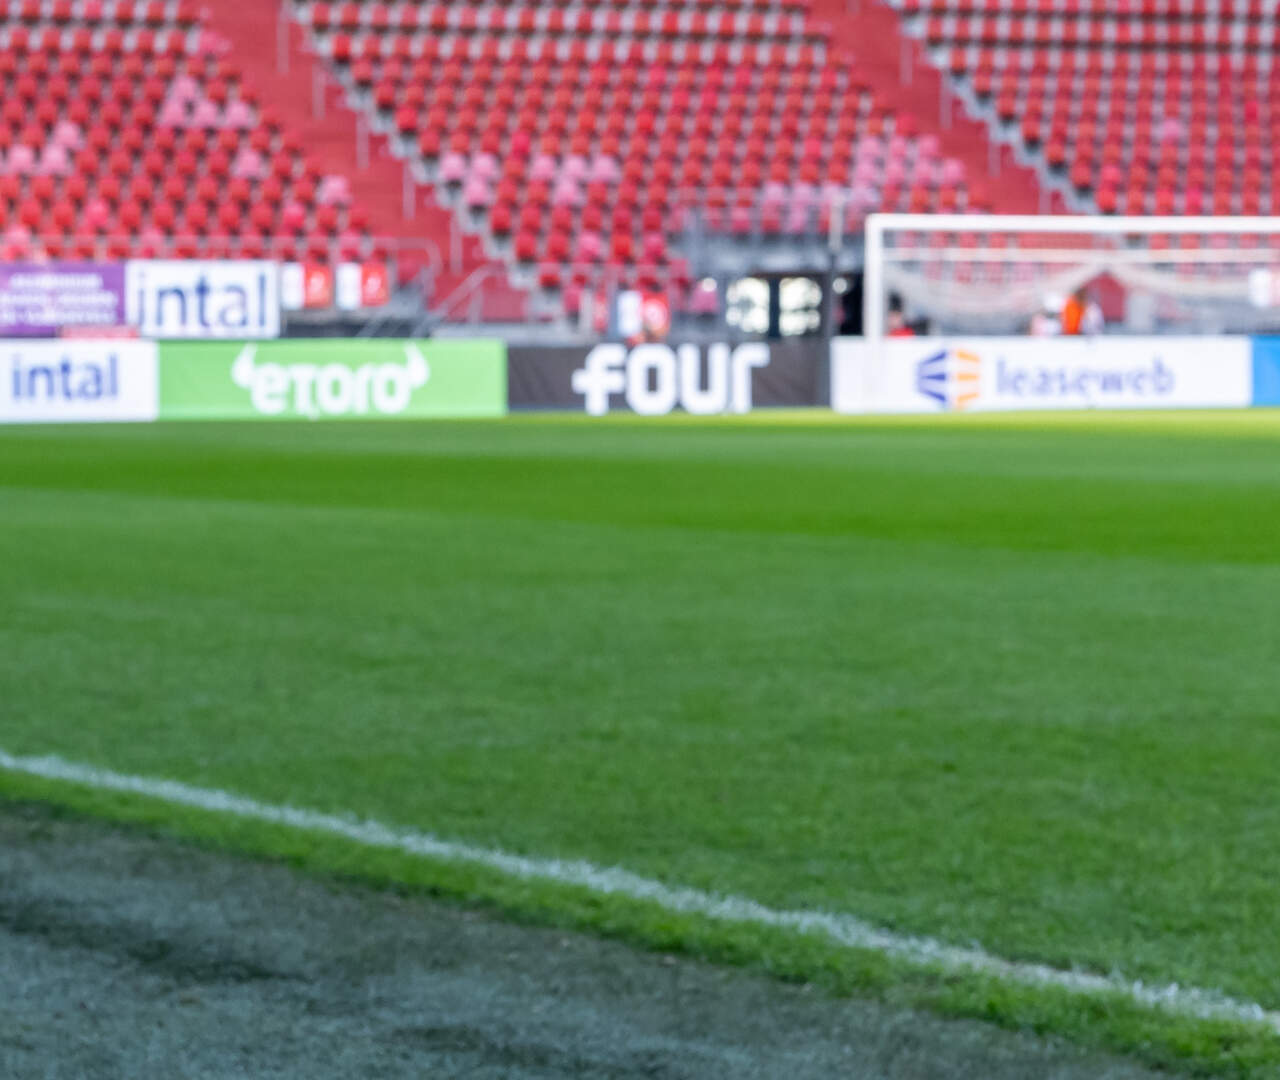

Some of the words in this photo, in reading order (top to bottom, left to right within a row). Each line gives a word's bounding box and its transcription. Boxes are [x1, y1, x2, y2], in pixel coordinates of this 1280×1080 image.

[138, 270, 266, 328] intal
[12, 352, 118, 400] intal
[996, 356, 1176, 395] leaseweb
